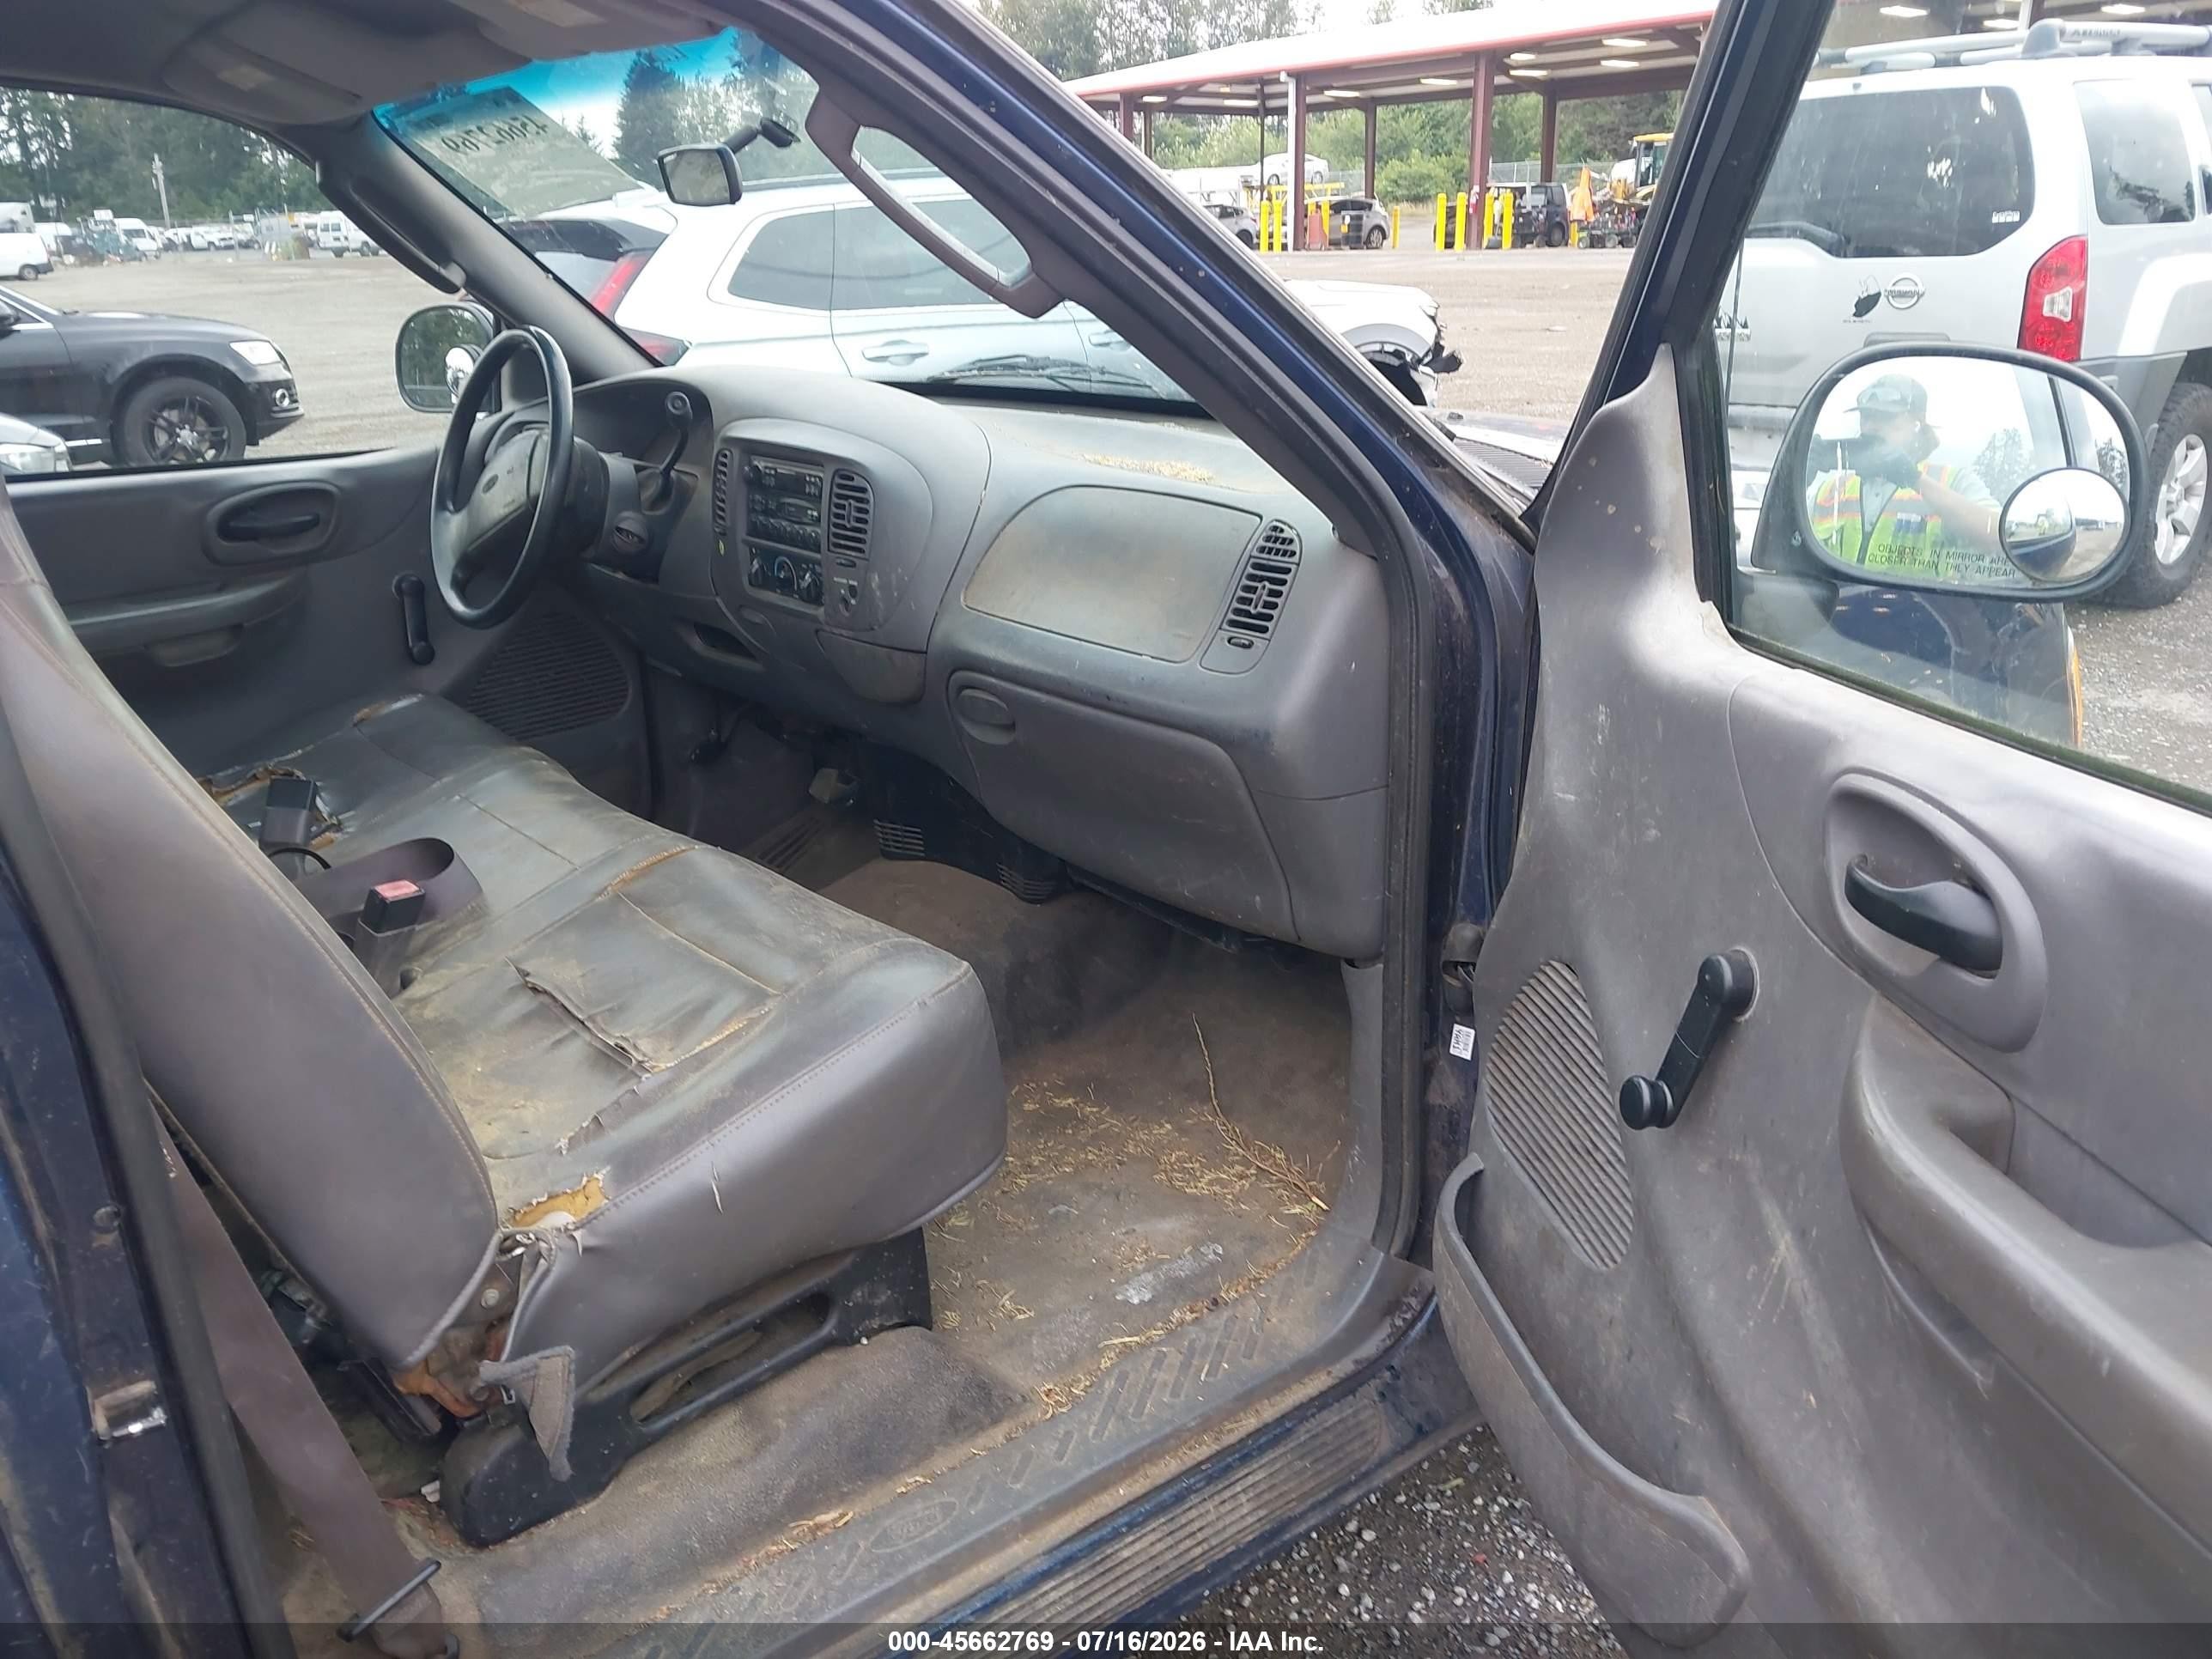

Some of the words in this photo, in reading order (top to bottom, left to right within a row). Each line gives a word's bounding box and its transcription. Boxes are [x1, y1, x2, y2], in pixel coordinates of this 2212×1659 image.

[1878, 544, 1923, 556] OBJECTS
[1929, 549, 1941, 558] IN
[1945, 550, 1985, 564] MIRROR
[1868, 553, 1907, 566] CLOSER
[1913, 558, 1940, 570] THAN
[1945, 562, 1971, 573] THEY
[1974, 565, 2016, 579] APPEAR
